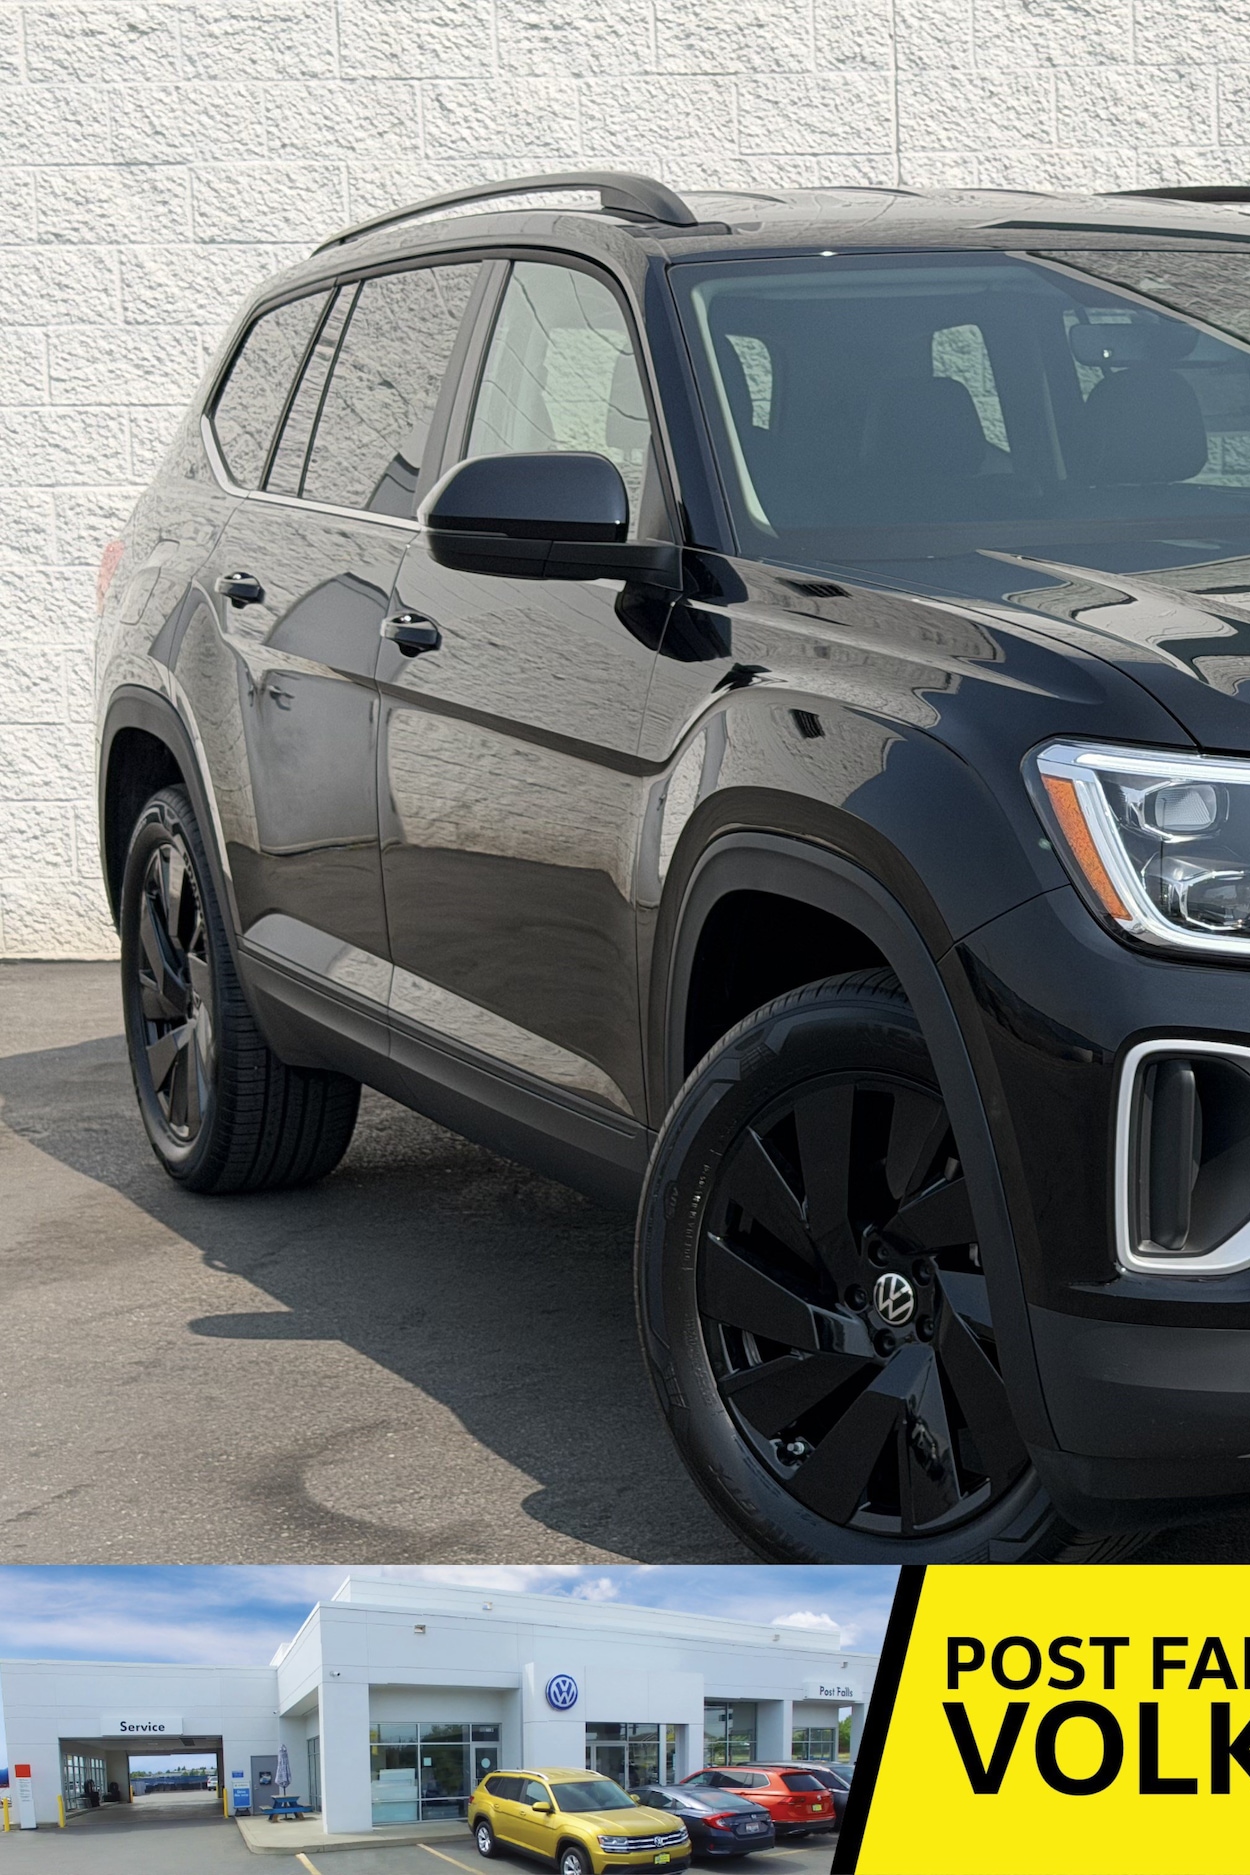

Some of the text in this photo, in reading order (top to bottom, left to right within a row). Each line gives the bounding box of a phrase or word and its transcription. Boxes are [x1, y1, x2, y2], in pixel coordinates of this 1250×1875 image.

[819, 1686, 853, 1697] Post Falls
[120, 1720, 165, 1732] Service
